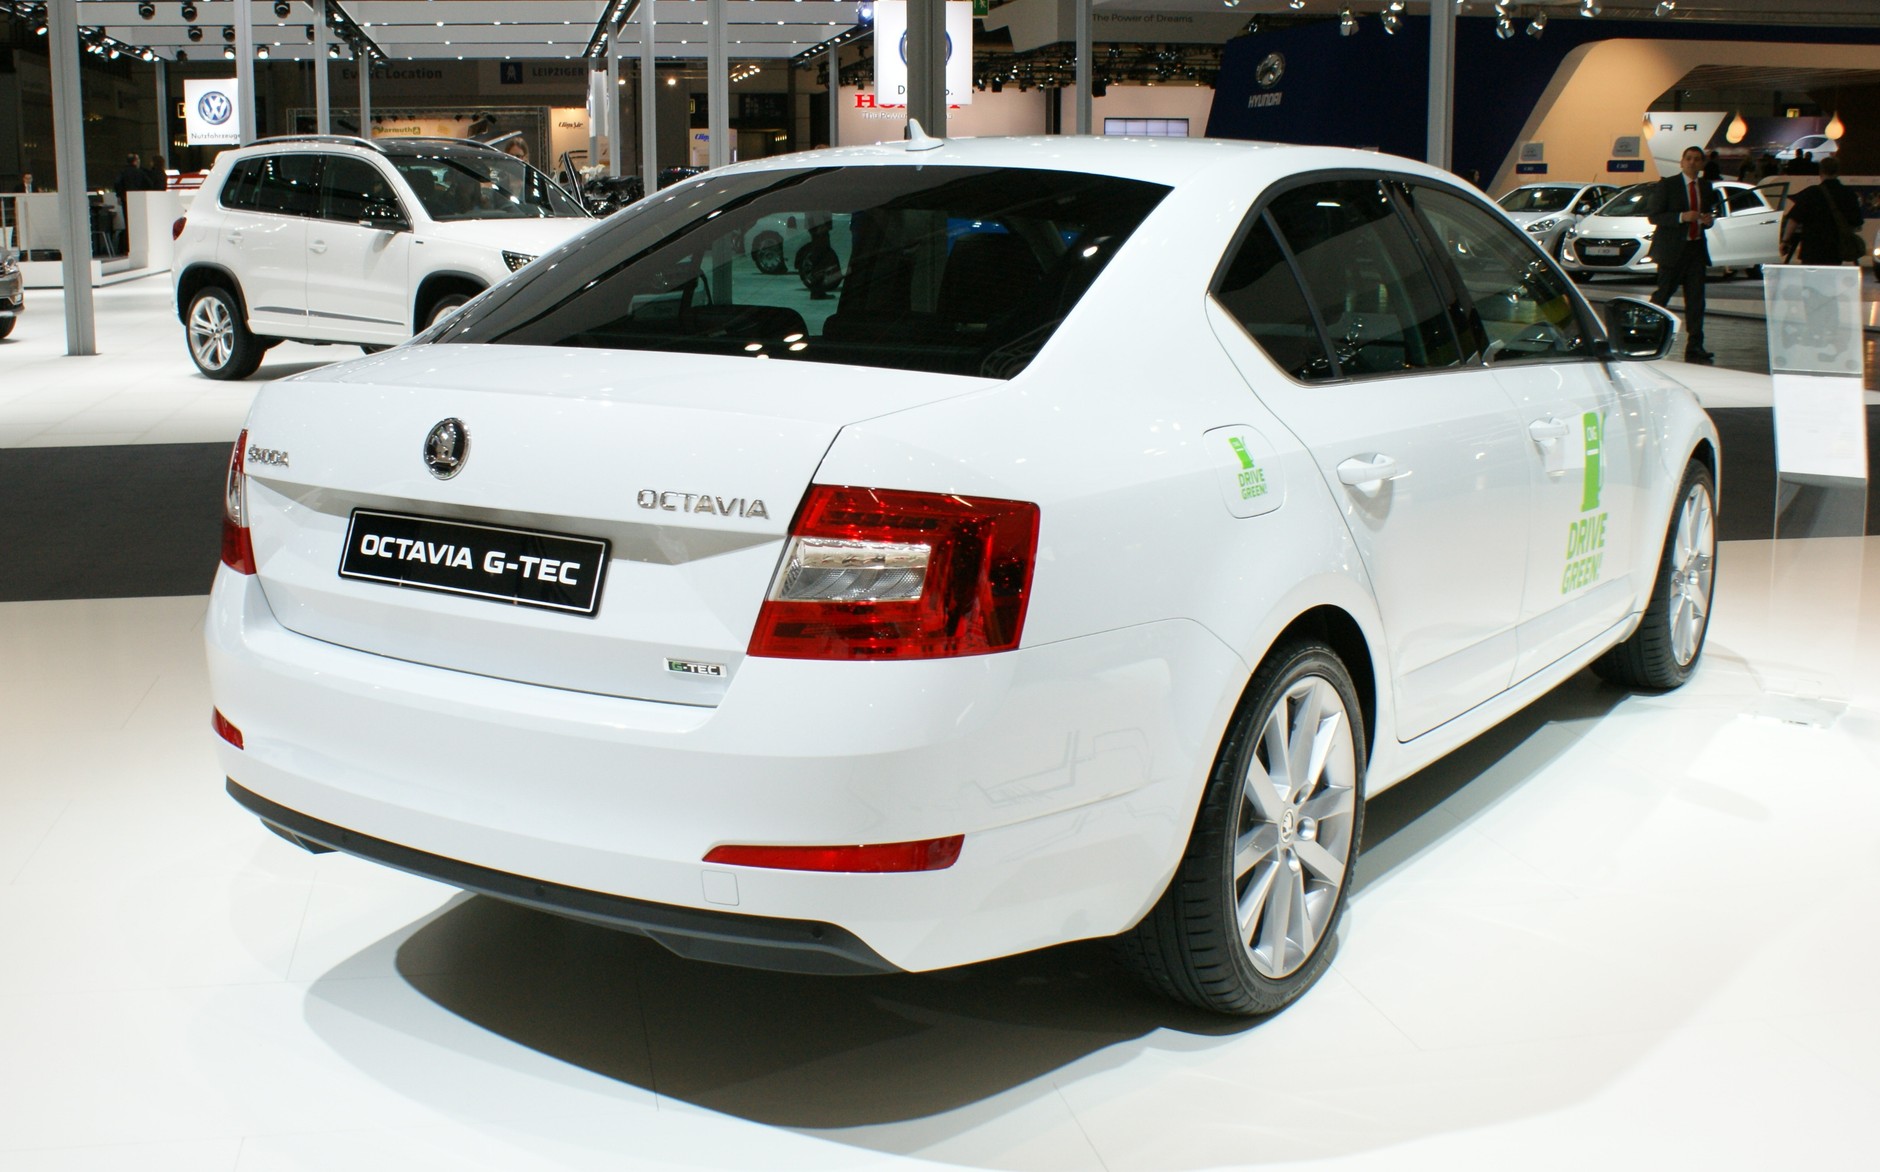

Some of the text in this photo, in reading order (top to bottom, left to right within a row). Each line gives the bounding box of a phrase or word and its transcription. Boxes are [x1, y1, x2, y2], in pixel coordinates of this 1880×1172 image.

[1092, 13, 1193, 23] The Power of Dreams
[386, 67, 443, 79] Location
[531, 67, 584, 77] LEIPZIGER
[1247, 91, 1284, 109] HYUNDAI
[1238, 469, 1265, 487] DRIVE
[1240, 483, 1268, 500] GREEN!
[637, 489, 769, 520] OCTAVIA
[1566, 512, 1608, 560] DRIVE
[360, 534, 581, 586] OCTAVIA G-TEC
[1561, 553, 1603, 594] GREEN!
[671, 661, 719, 676] G-TEC
